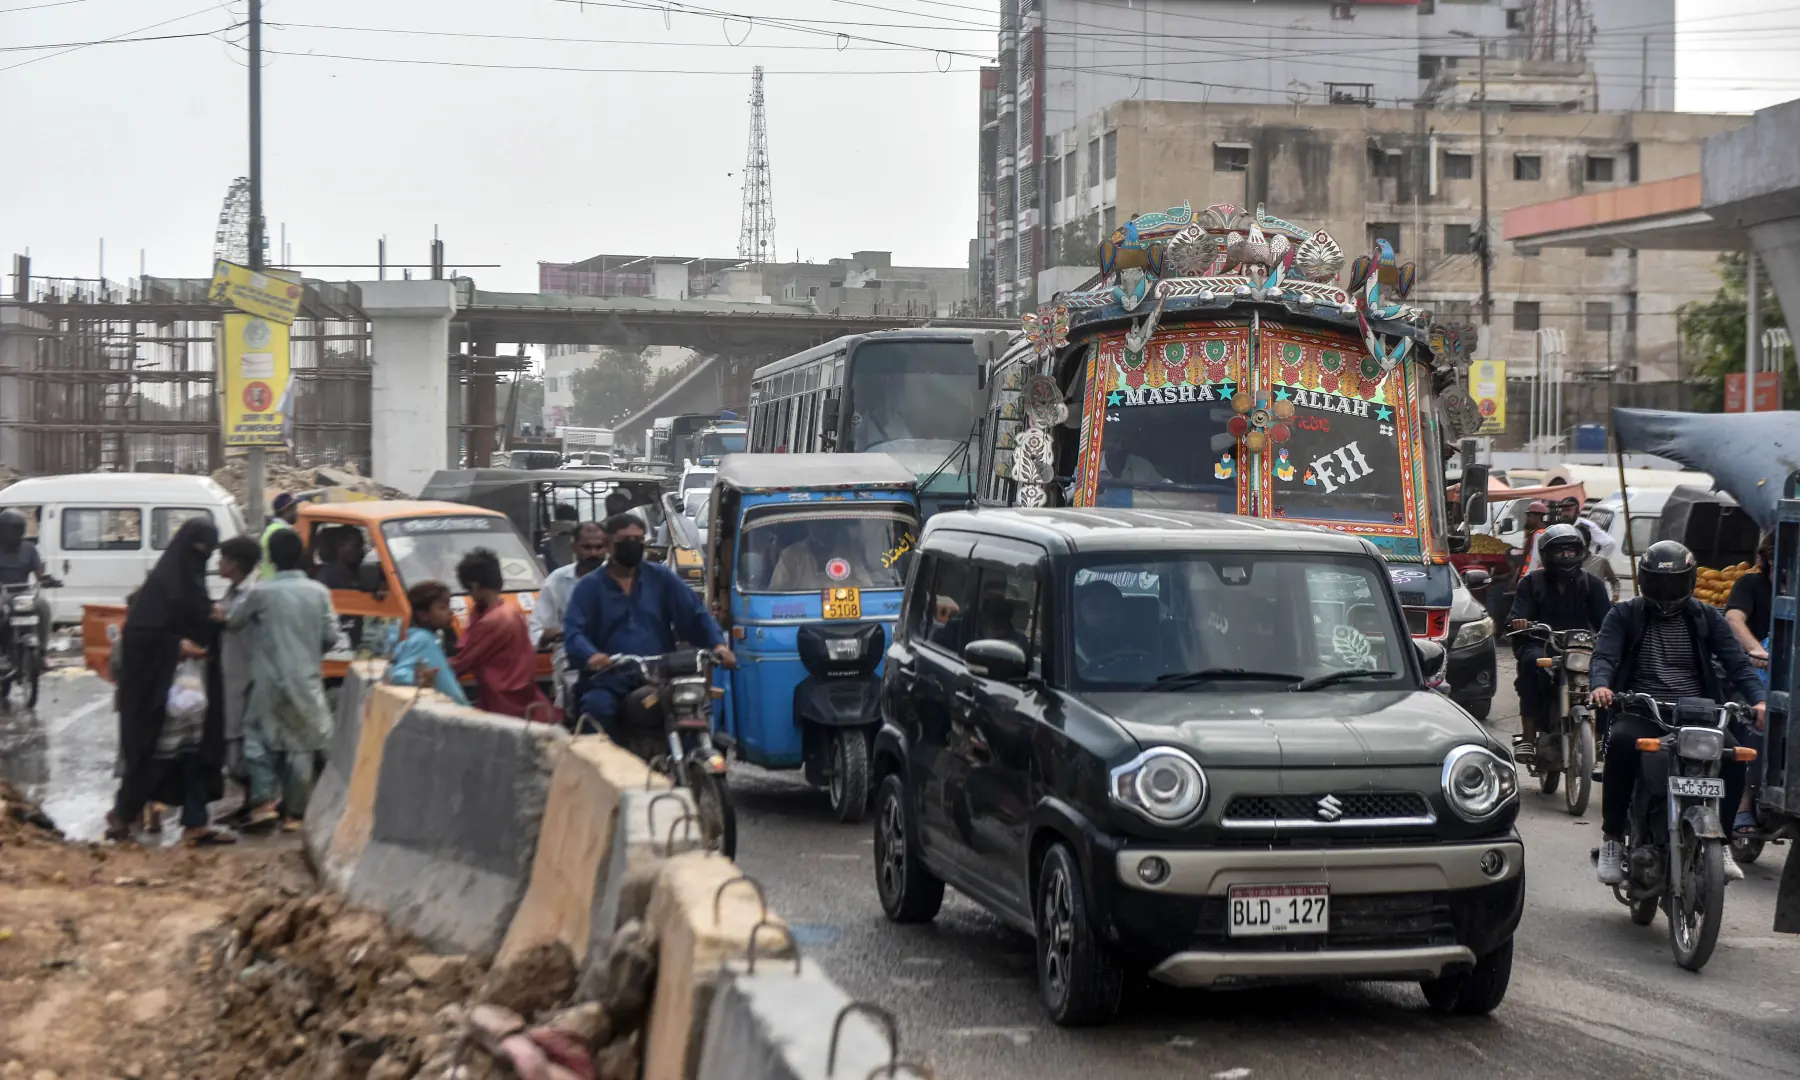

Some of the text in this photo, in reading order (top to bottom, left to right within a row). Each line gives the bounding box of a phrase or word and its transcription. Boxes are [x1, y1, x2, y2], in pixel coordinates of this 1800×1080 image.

[1124, 384, 1371, 418] MASHA ALLAH
[830, 603, 858, 617] 5108
[1697, 784, 1720, 796] 3723
[1233, 897, 1326, 926] BLD 127
